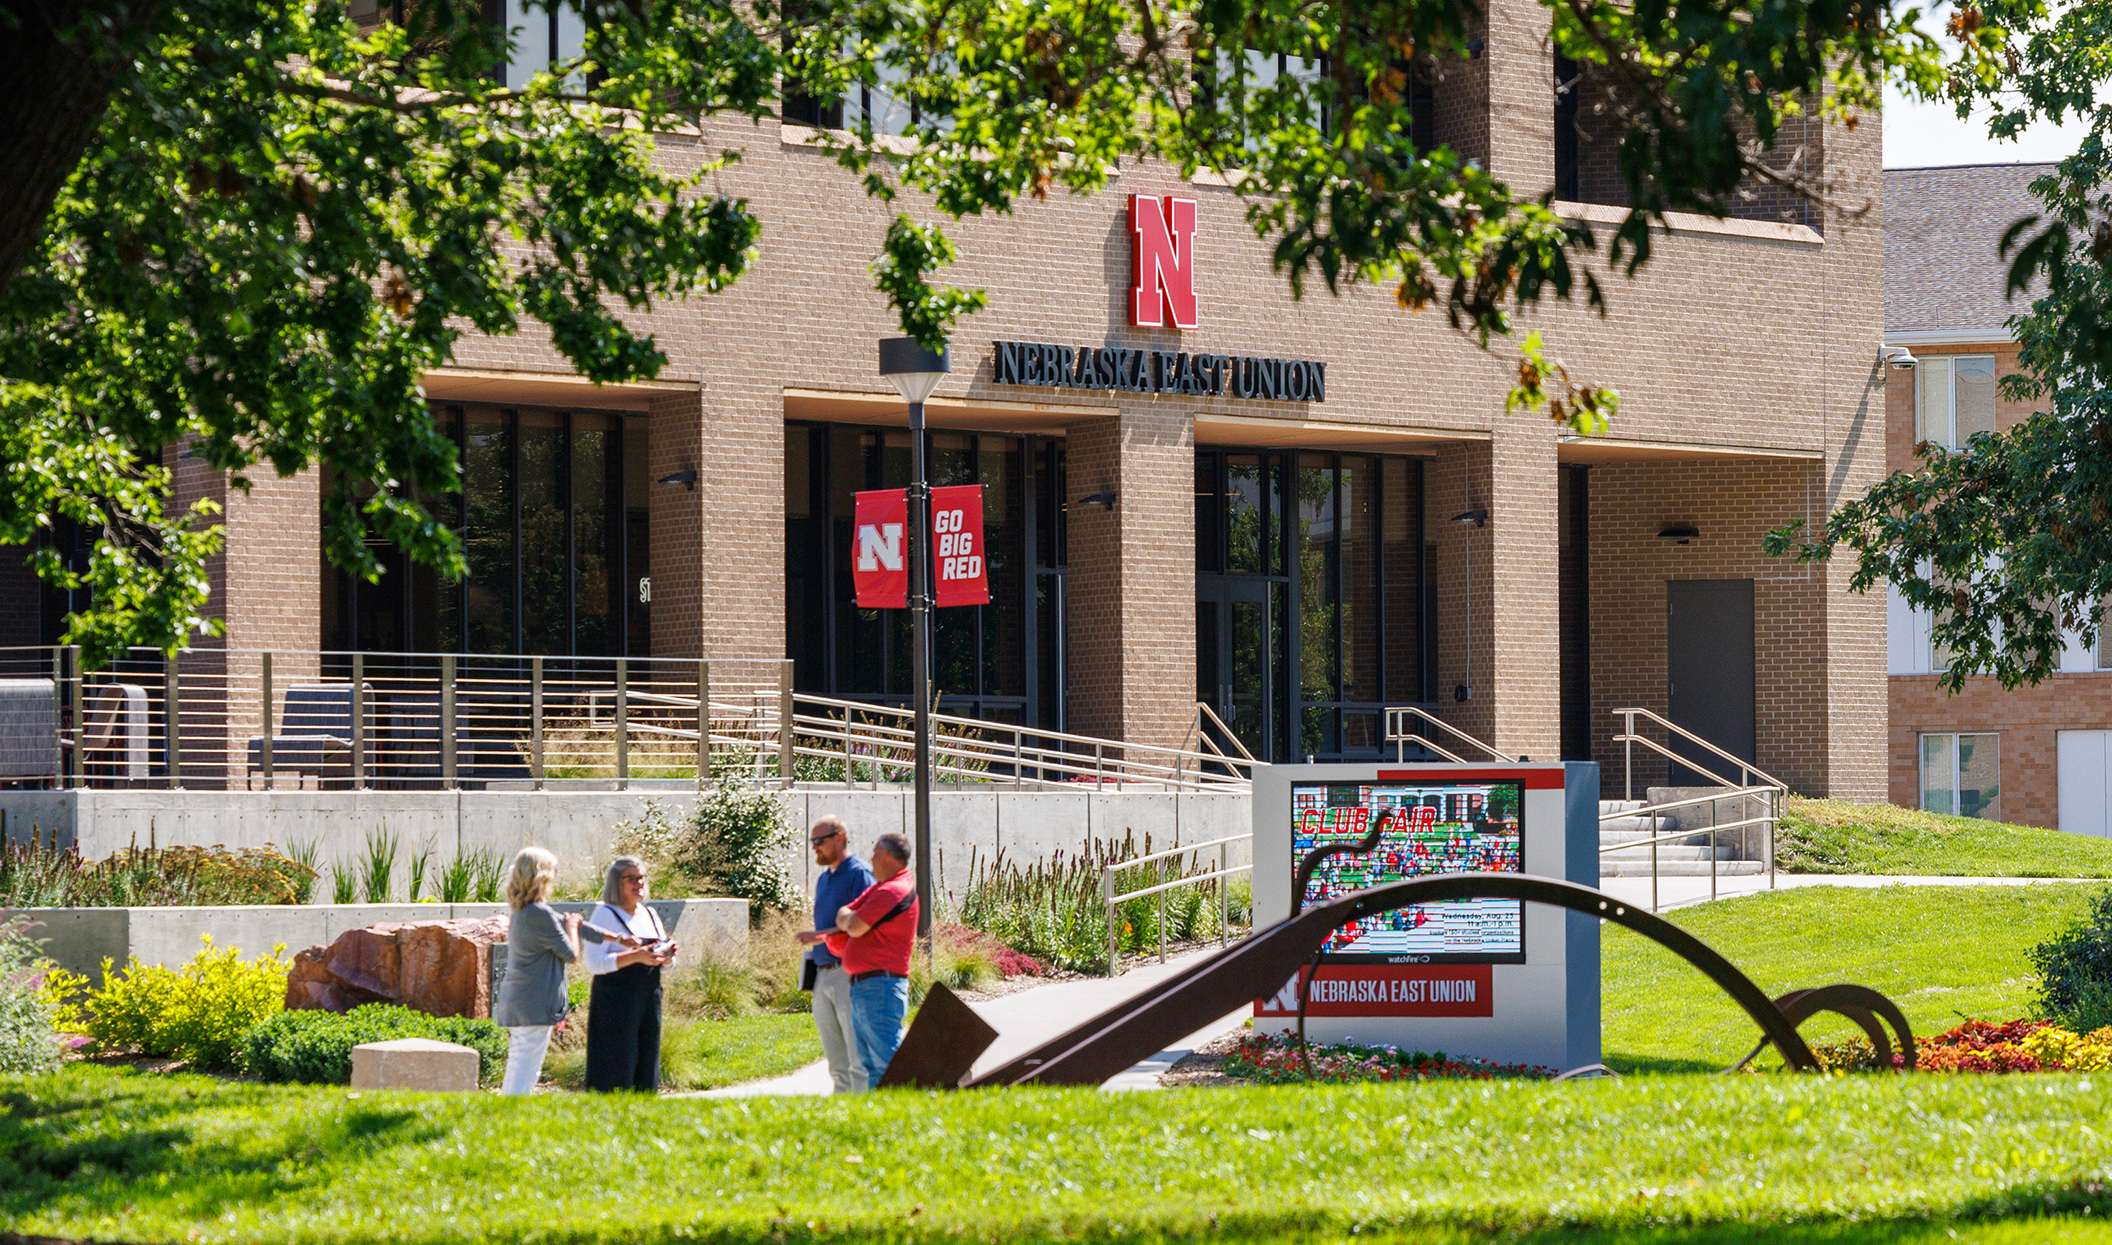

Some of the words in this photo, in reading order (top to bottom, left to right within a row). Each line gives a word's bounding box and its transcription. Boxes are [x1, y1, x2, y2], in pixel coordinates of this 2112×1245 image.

[1129, 194, 1198, 328] N
[994, 341, 1153, 392] NEBRASKA
[1157, 351, 1229, 397] EAST
[1231, 357, 1326, 402] UNION
[935, 509, 963, 533] GO
[858, 522, 903, 572] N
[939, 532, 973, 557] BIG
[943, 555, 981, 580] RED
[1300, 807, 1369, 834] CLUB
[1310, 980, 1387, 1003] NEBRASKA
[1391, 980, 1428, 1003] EAST
[1430, 980, 1476, 1003] UNION
